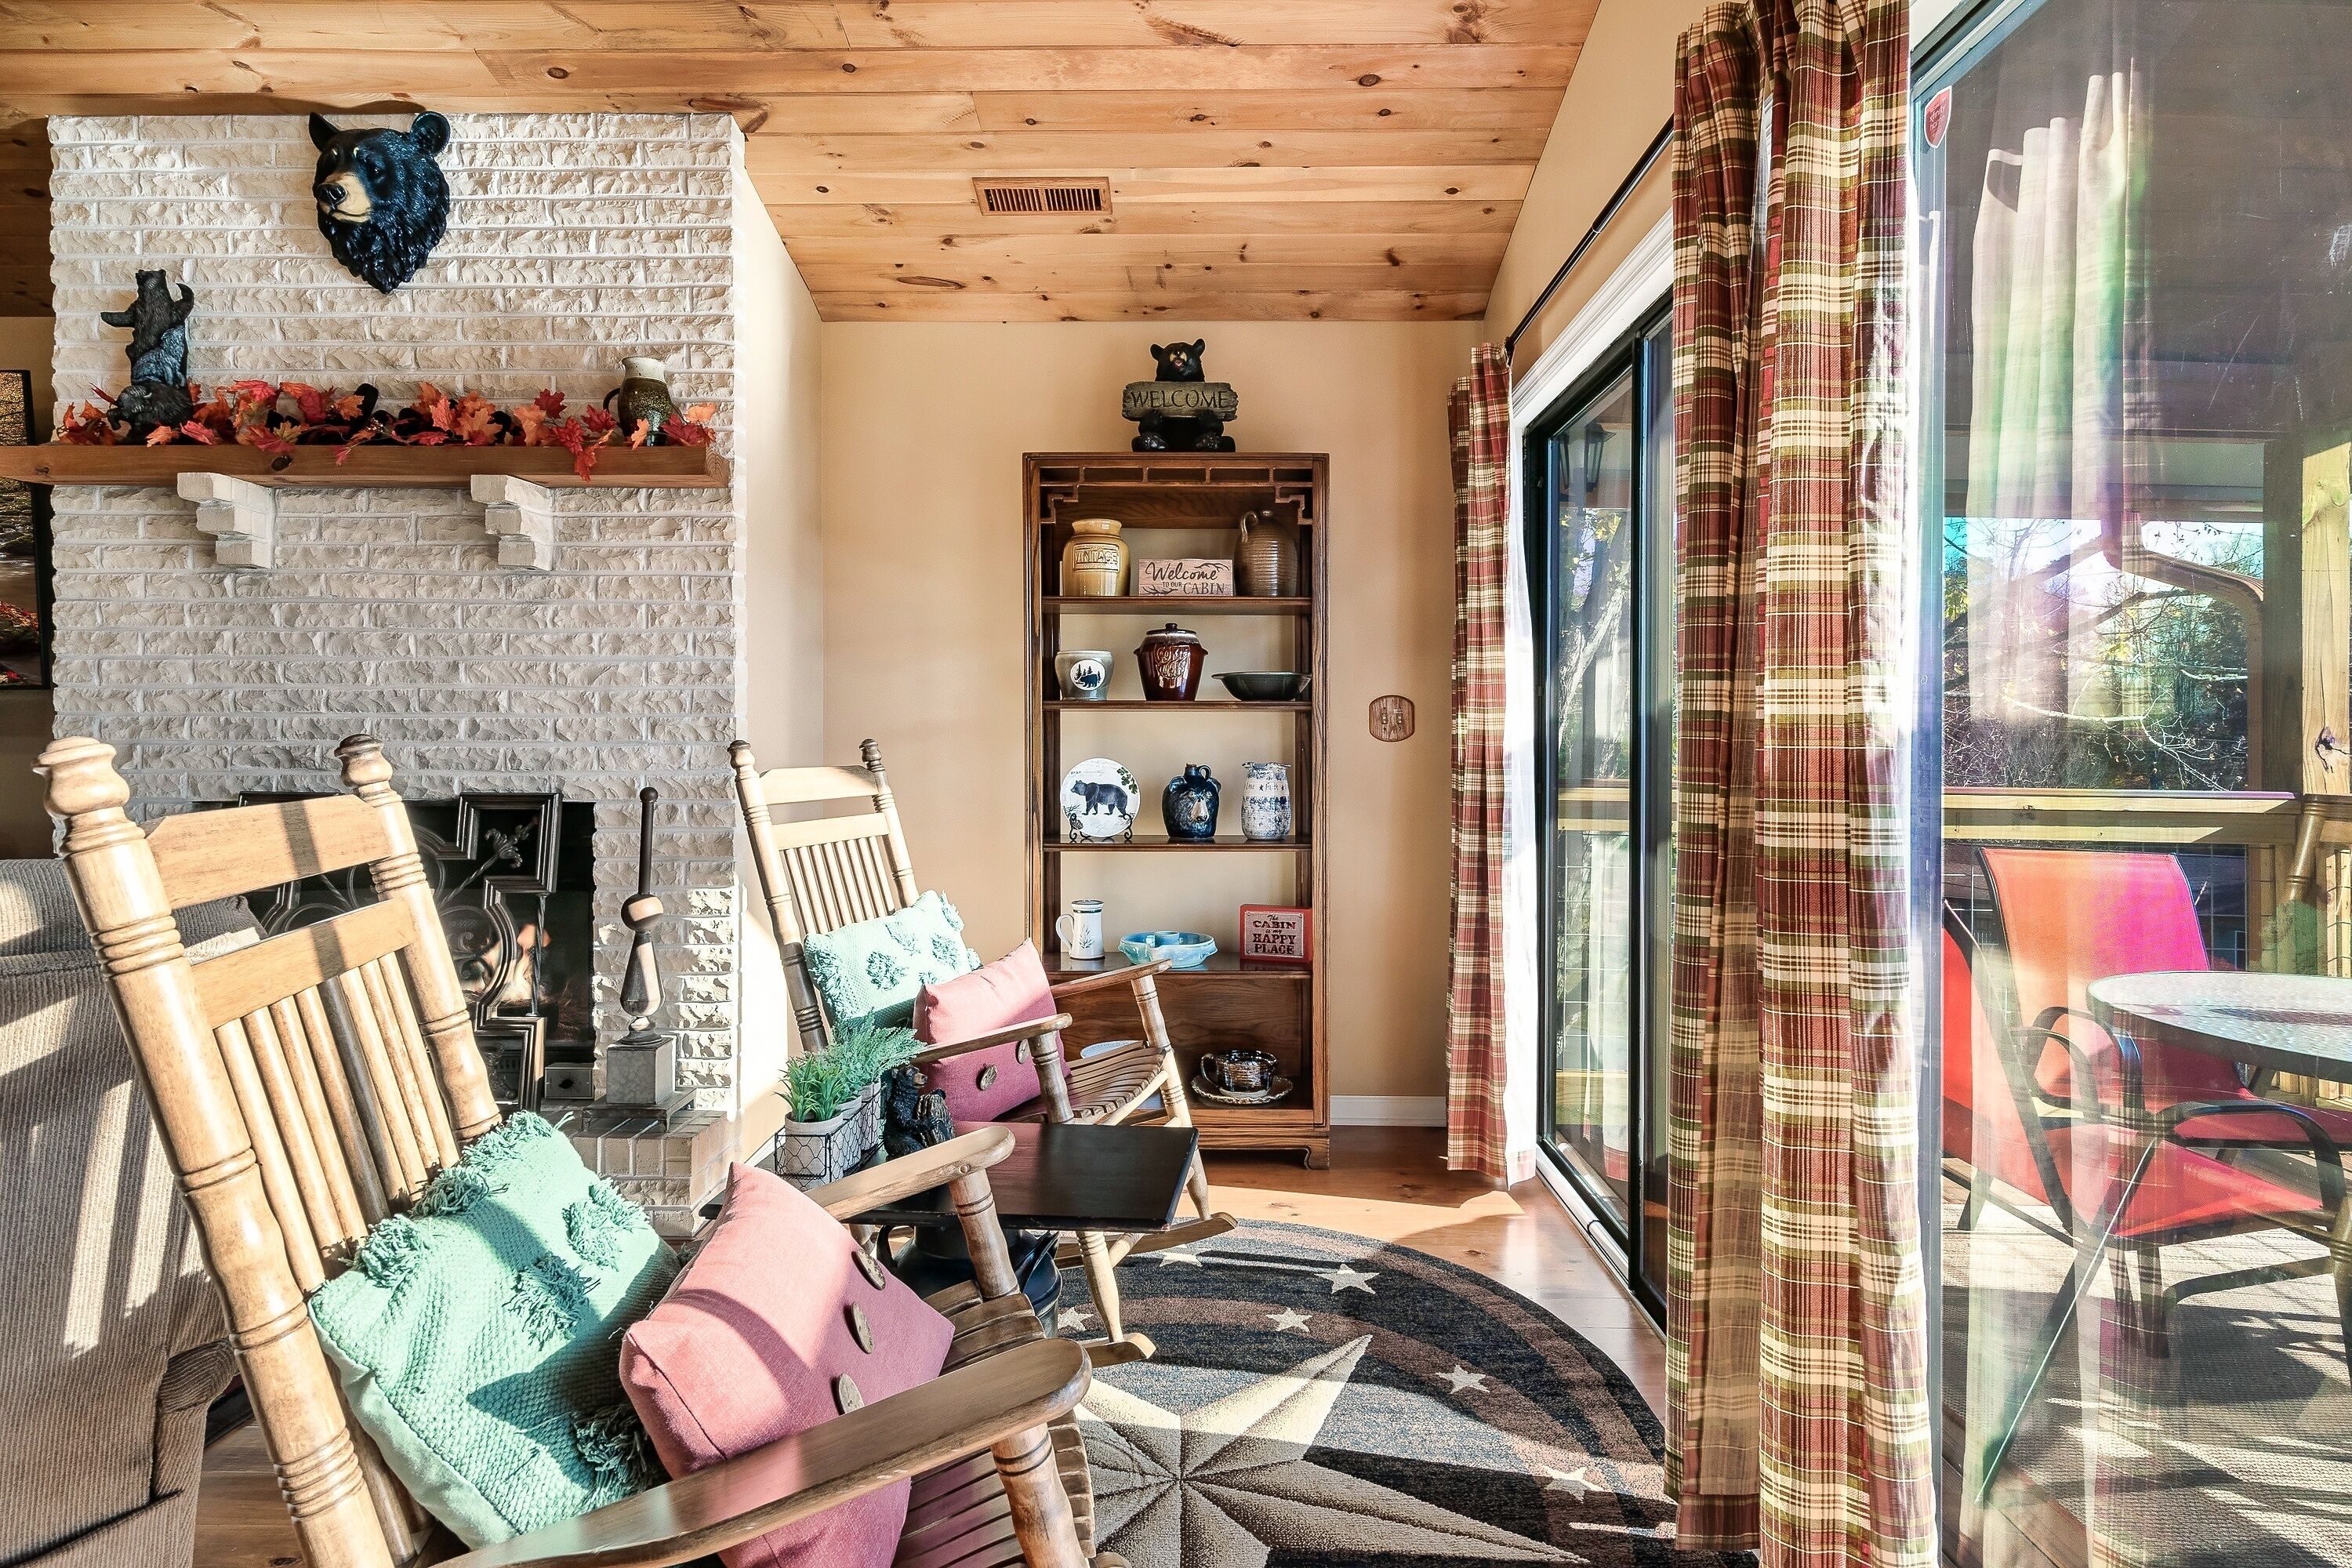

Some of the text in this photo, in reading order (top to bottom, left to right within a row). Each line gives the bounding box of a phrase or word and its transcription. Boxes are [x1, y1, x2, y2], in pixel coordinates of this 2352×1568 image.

[1130, 389, 1229, 408] WELCOME
[1075, 550, 1118, 564] VINTAGE
[1145, 561, 1218, 581] Welcome
[1183, 582, 1225, 594] CABIN
[1252, 920, 1296, 929] CABIN
[1252, 933, 1296, 944] HAPPY
[1254, 943, 1294, 954] PLACE
